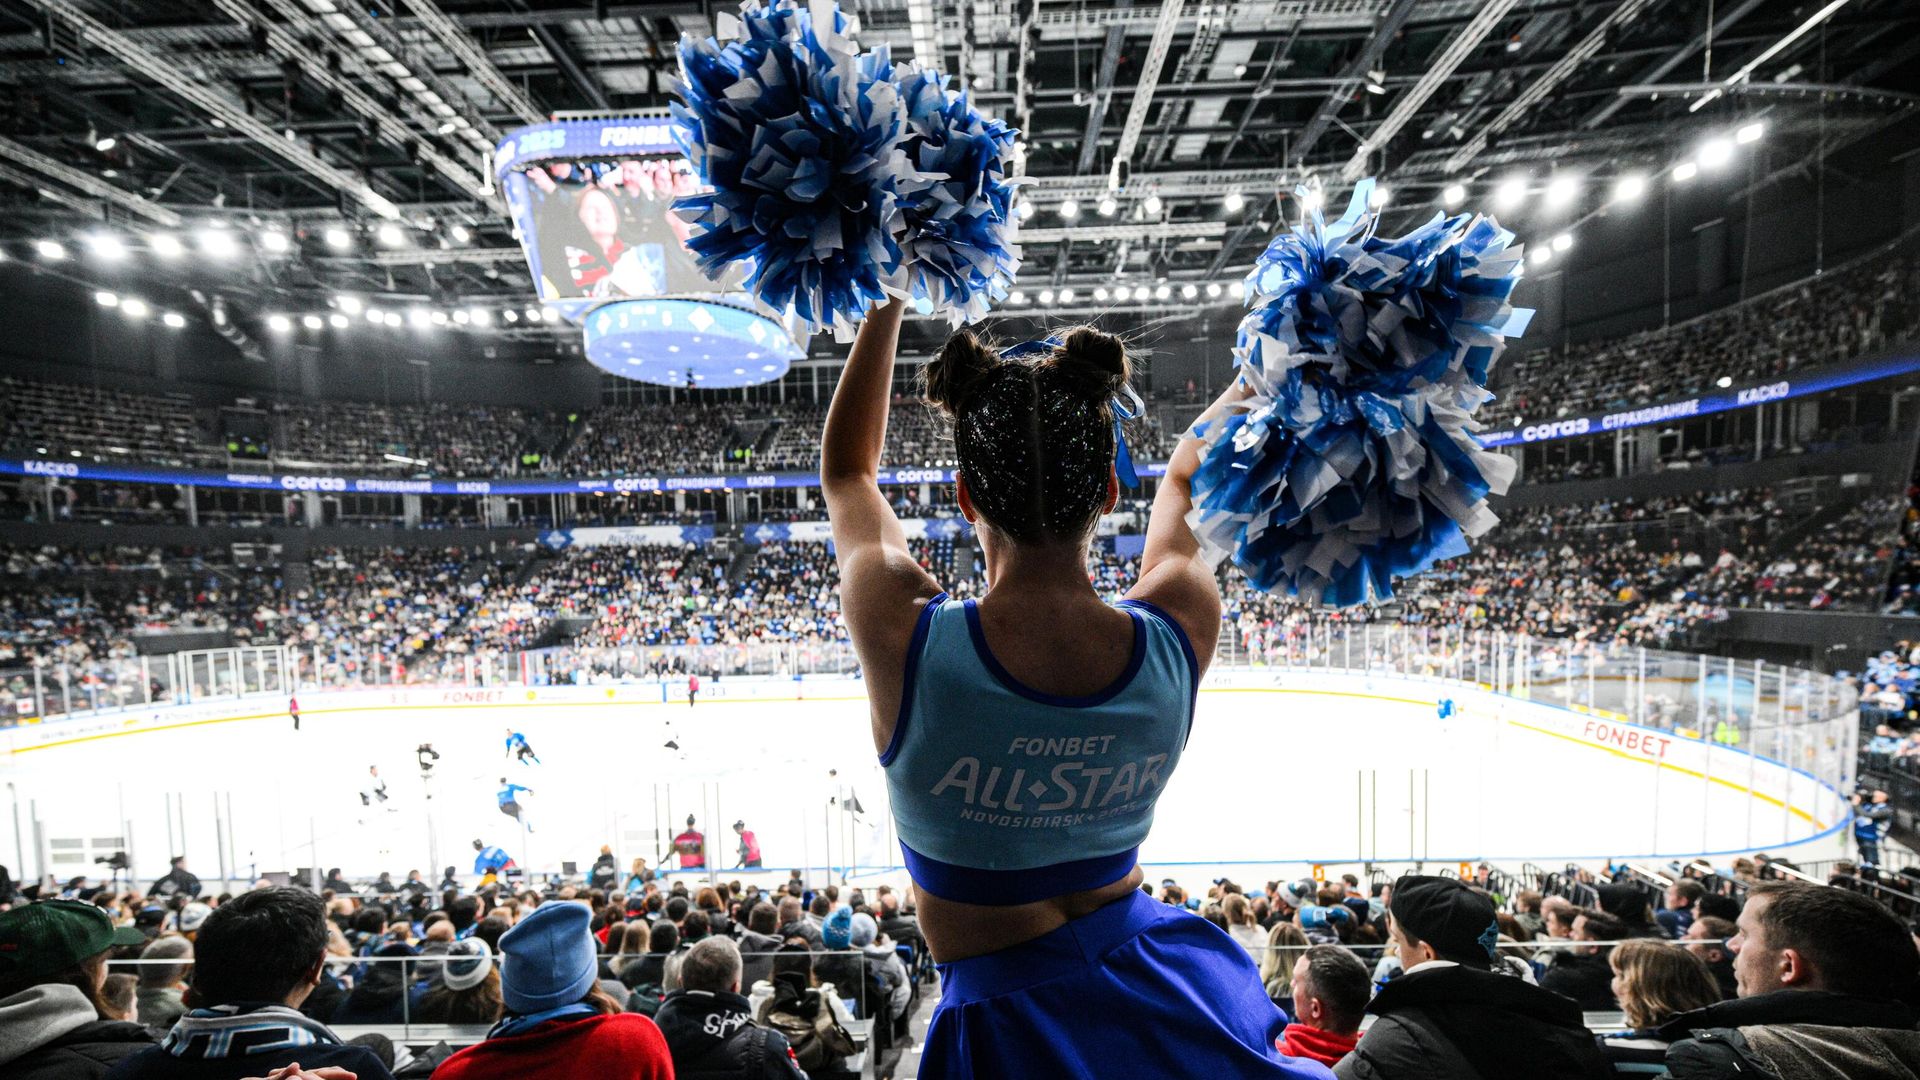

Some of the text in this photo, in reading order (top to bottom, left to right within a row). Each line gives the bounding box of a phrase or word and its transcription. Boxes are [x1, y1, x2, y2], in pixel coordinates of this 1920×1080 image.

[1601, 399, 1700, 430] СТРАХОВАНИЕ
[1737, 381, 1790, 405] КАСКО
[23, 460, 79, 477] КАСКО
[443, 690, 505, 703] FONBET
[1008, 734, 1116, 757] FONBET
[1584, 721, 1671, 758] FONBET
[960, 808, 1086, 829] NOVOSIBIRSK
